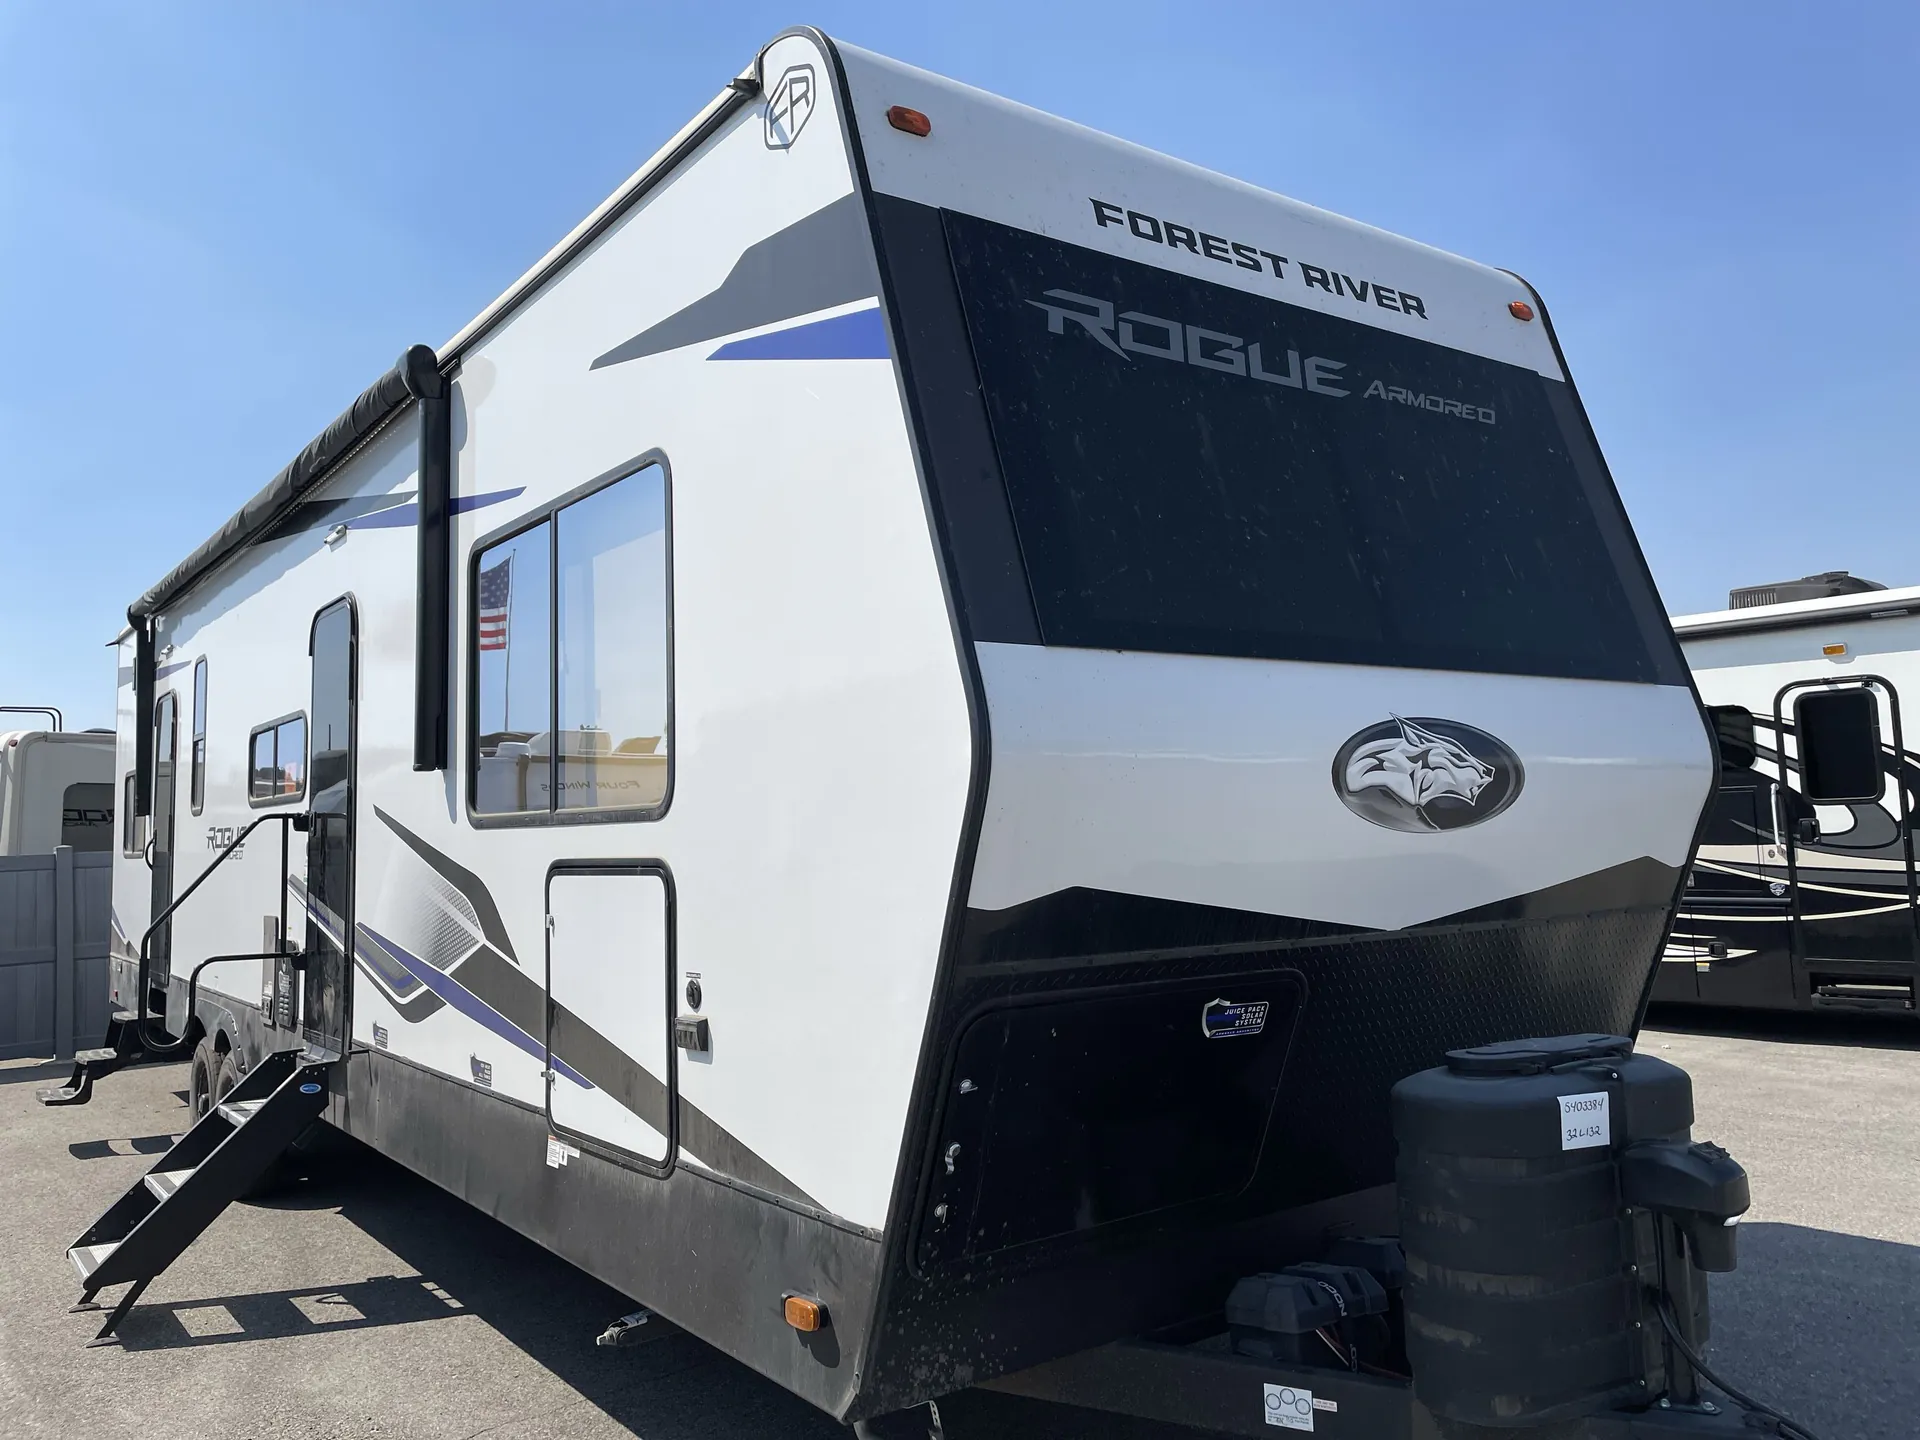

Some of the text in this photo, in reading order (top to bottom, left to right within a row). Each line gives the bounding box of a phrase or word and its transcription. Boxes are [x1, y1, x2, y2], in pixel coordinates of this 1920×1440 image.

[1088, 197, 1429, 320] FOREST RIVER
[1023, 288, 1496, 425] ROGUE ARMORED
[1224, 1005, 1265, 1015] JUICE PACK
[1241, 1011, 1264, 1020] SOLAR
[1234, 1018, 1262, 1027] SYSTEM
